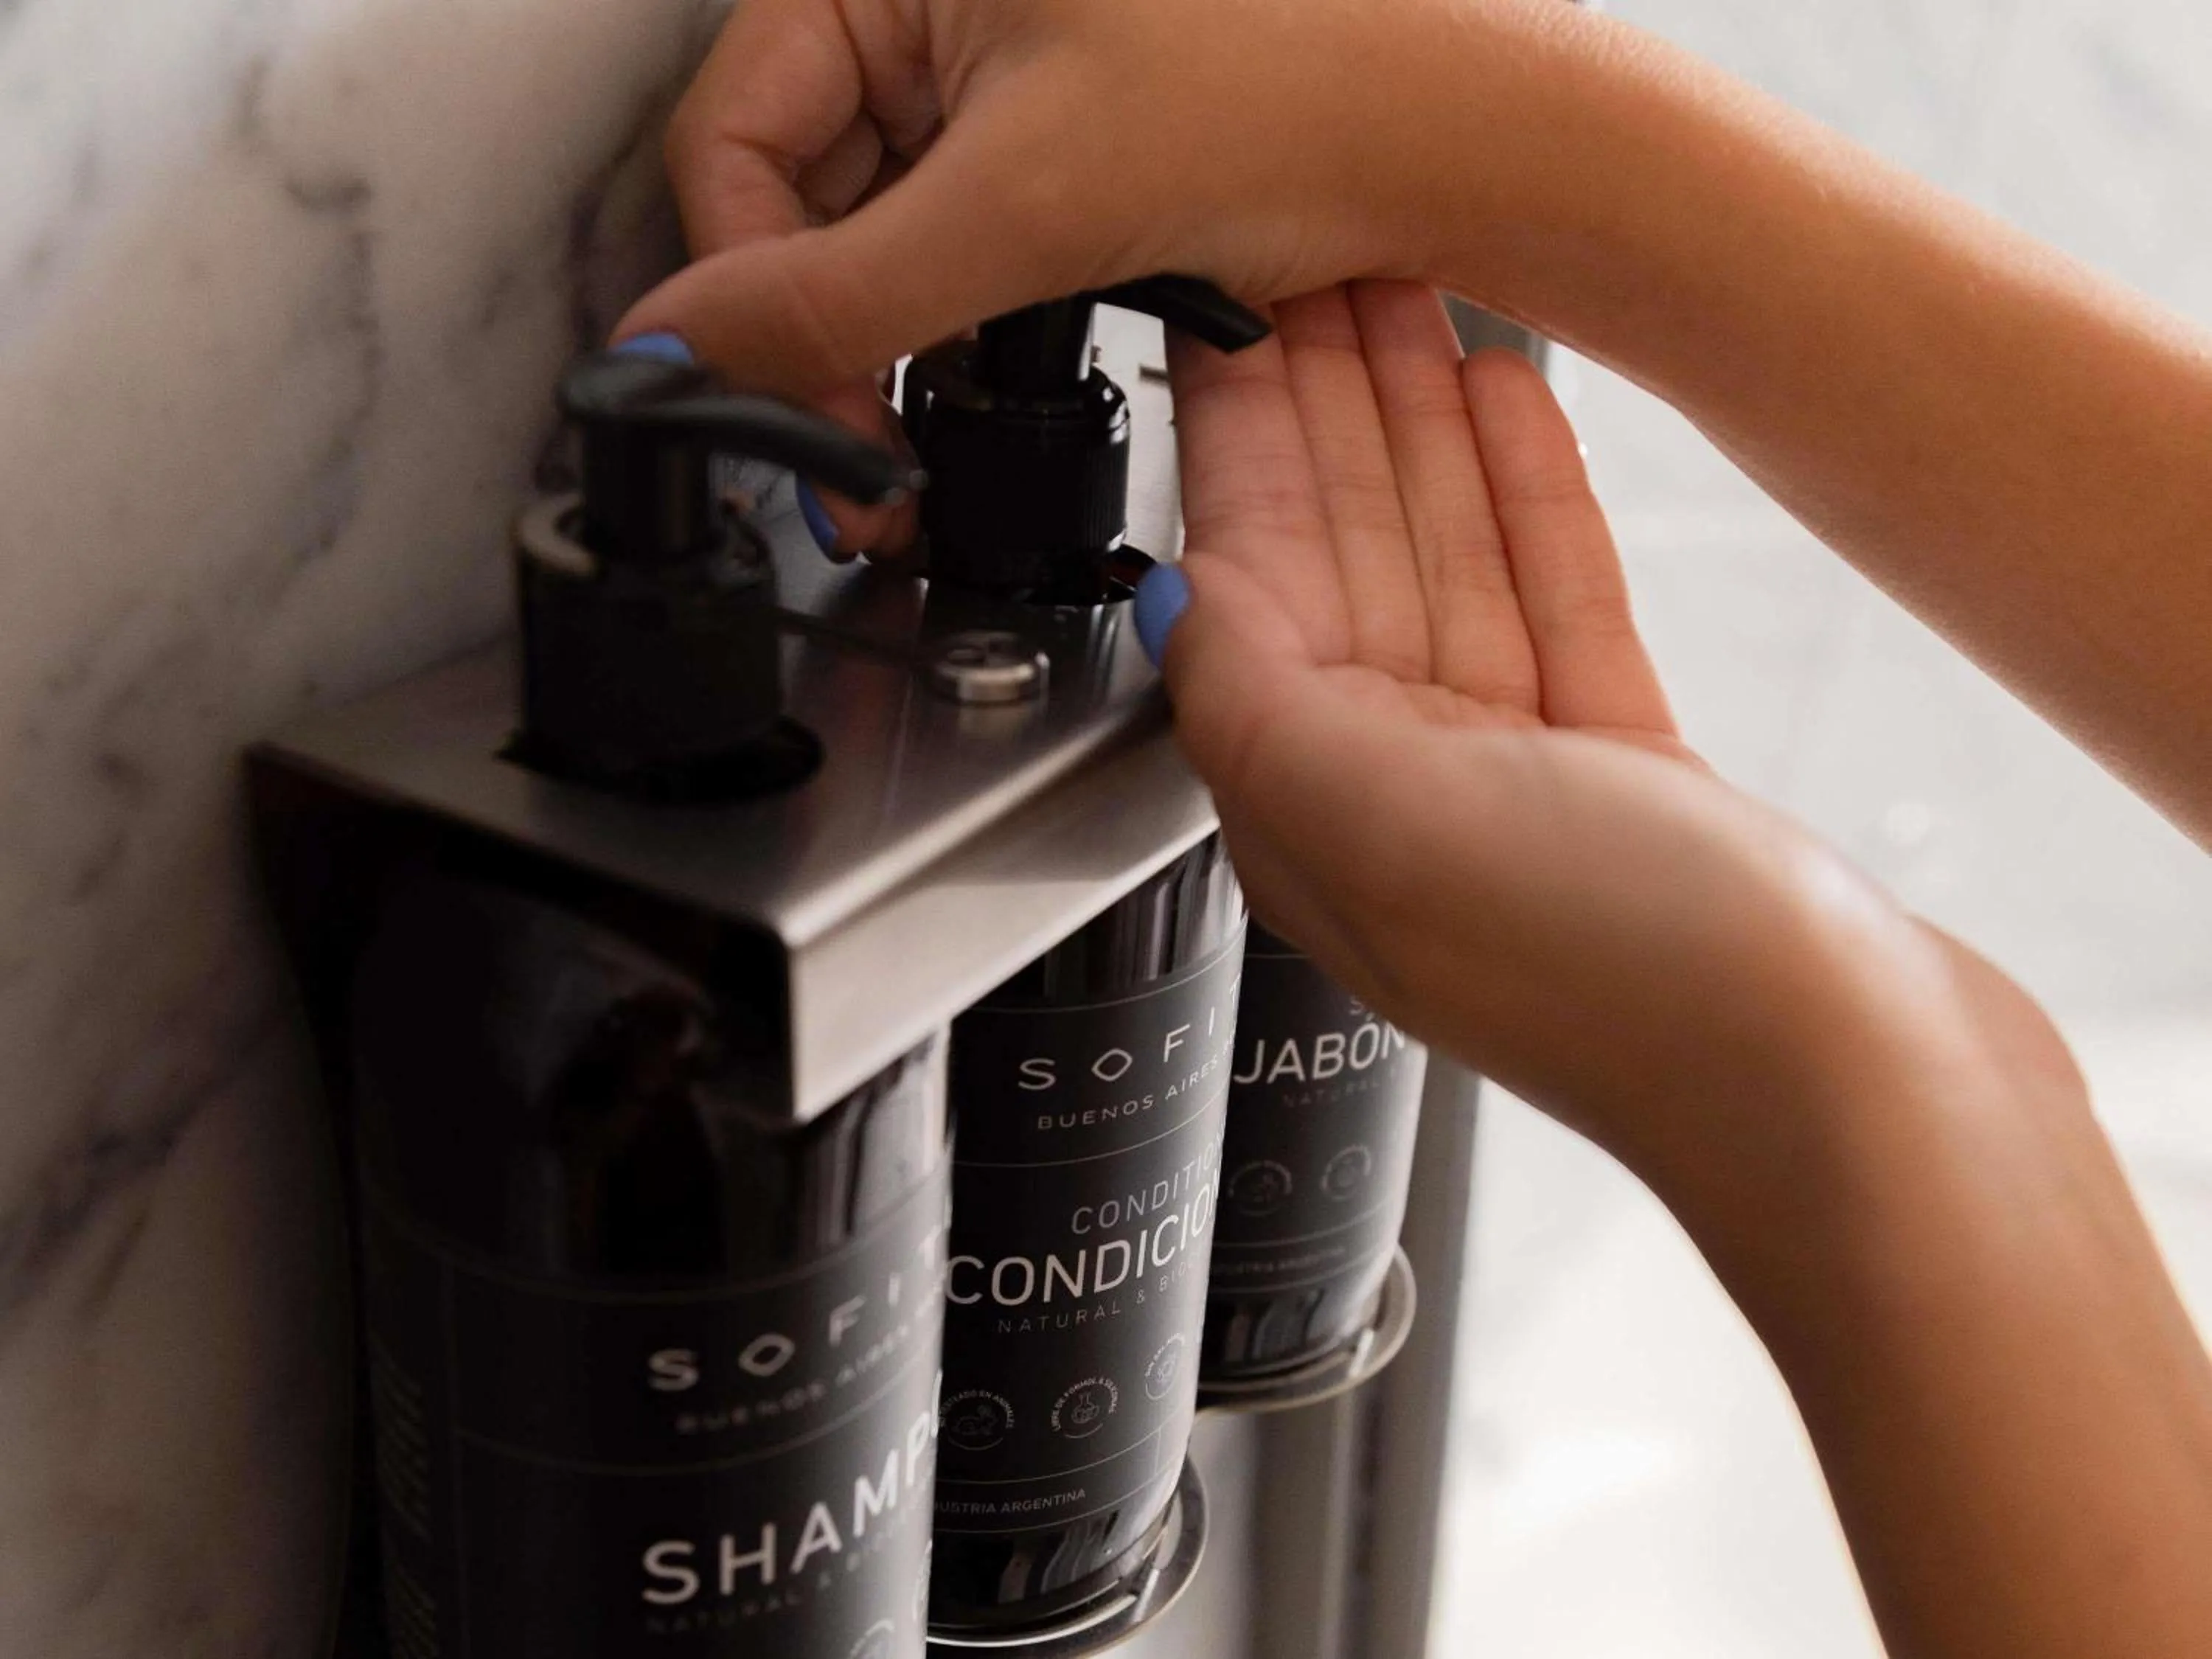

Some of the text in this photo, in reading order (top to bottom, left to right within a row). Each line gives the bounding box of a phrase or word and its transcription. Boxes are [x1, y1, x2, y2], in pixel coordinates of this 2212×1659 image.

[1037, 1057, 1219, 1130] BUENOS AIRES
[996, 1298, 1122, 1334] NATURAL
[1004, 1487, 1086, 1514] ARGENTINA
